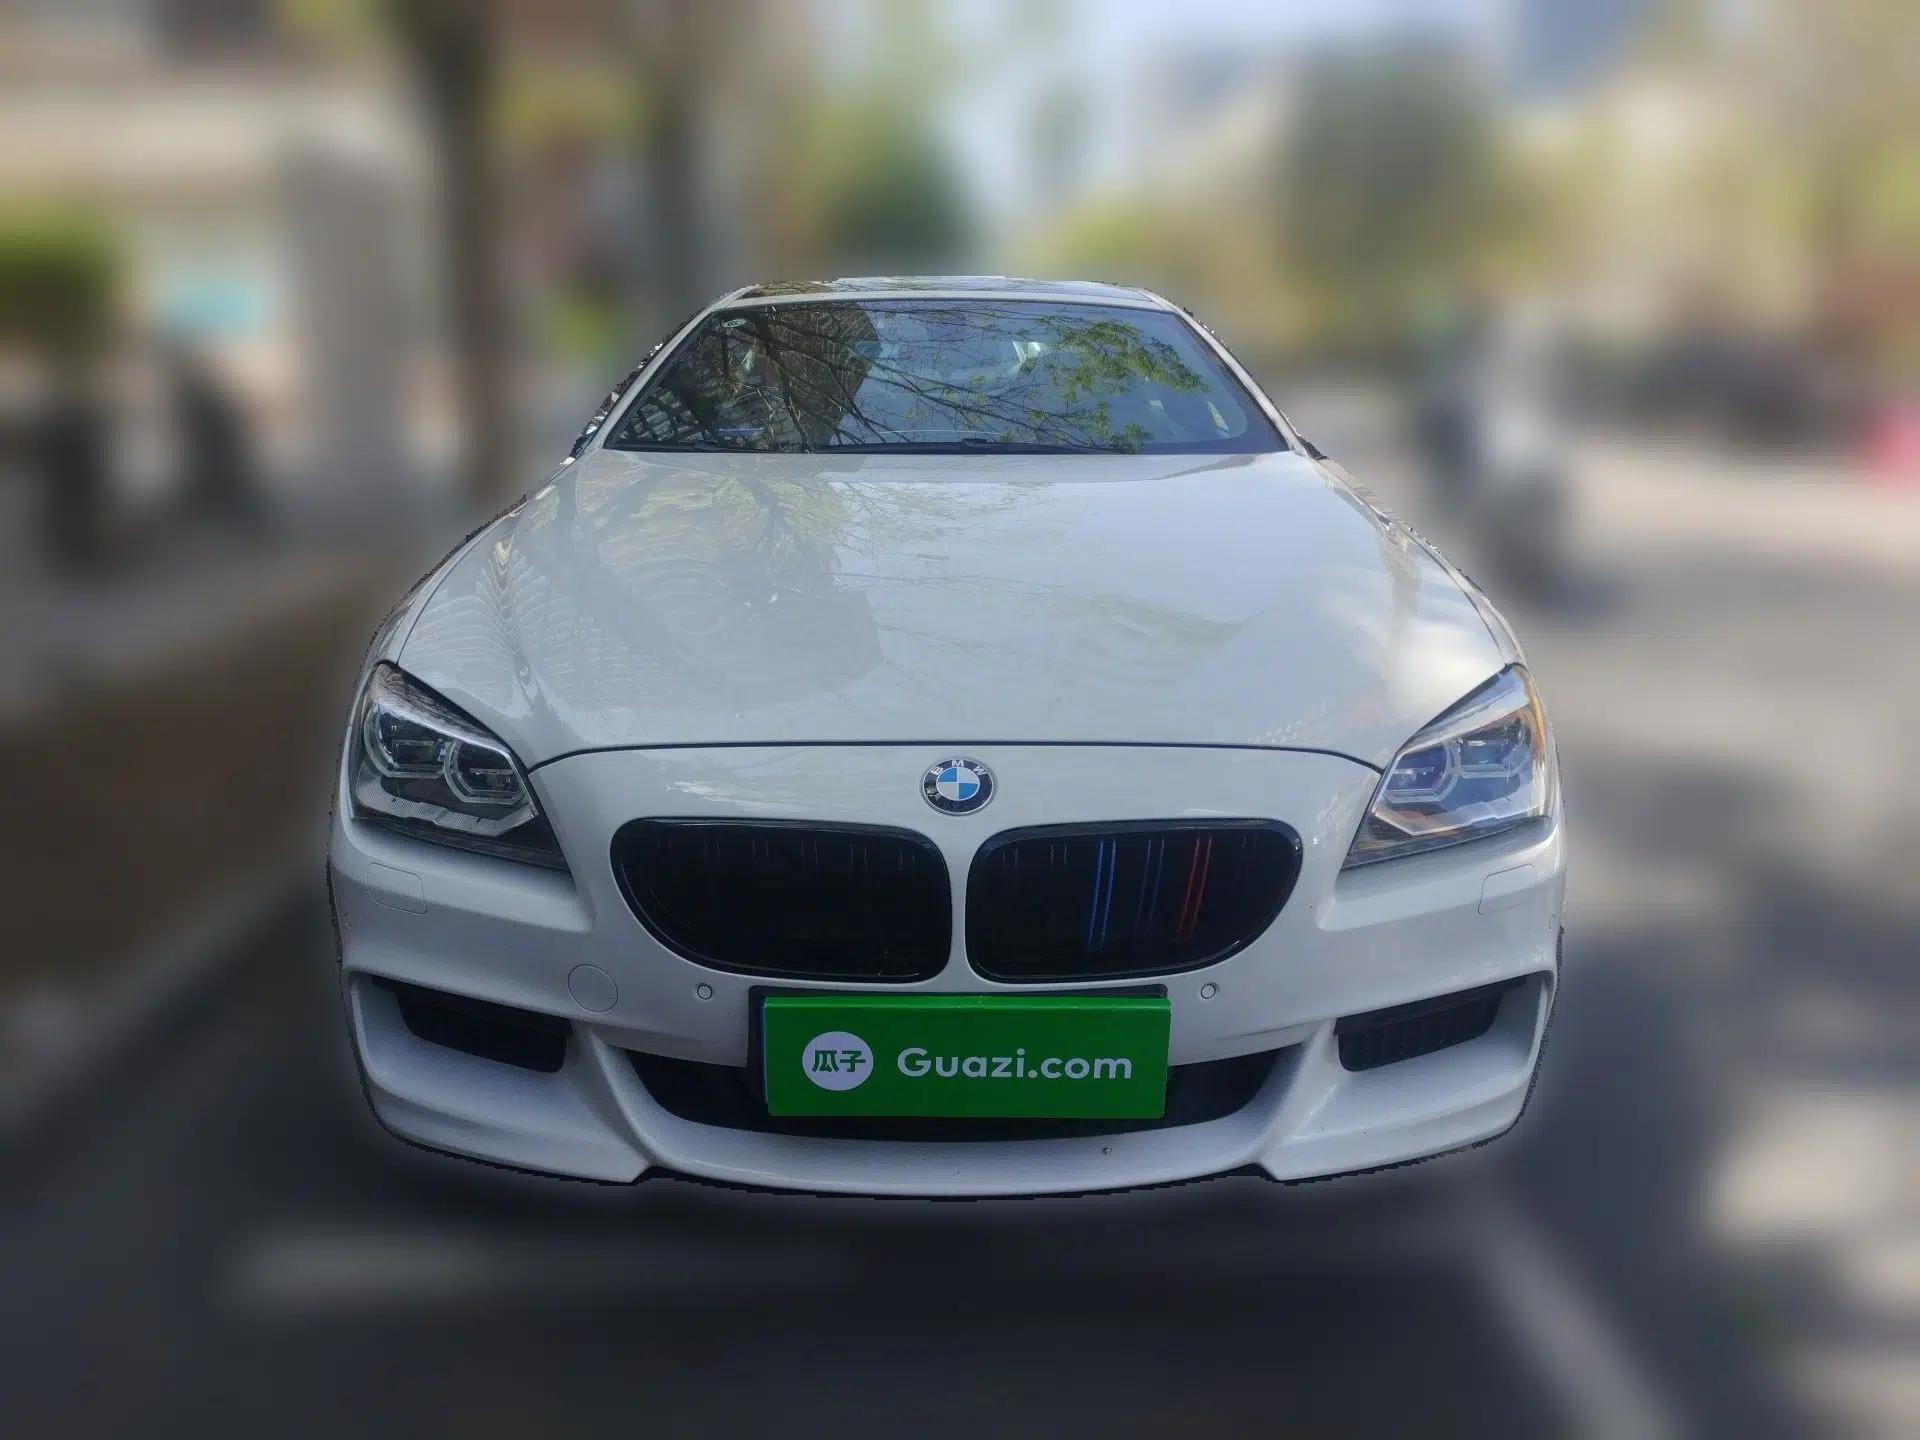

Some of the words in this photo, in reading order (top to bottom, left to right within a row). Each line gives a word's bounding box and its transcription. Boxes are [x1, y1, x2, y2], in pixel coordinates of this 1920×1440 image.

[930, 760, 987, 776] BMW
[812, 1049, 867, 1073] 瓜子
[897, 1047, 1133, 1079] Guazi.com
